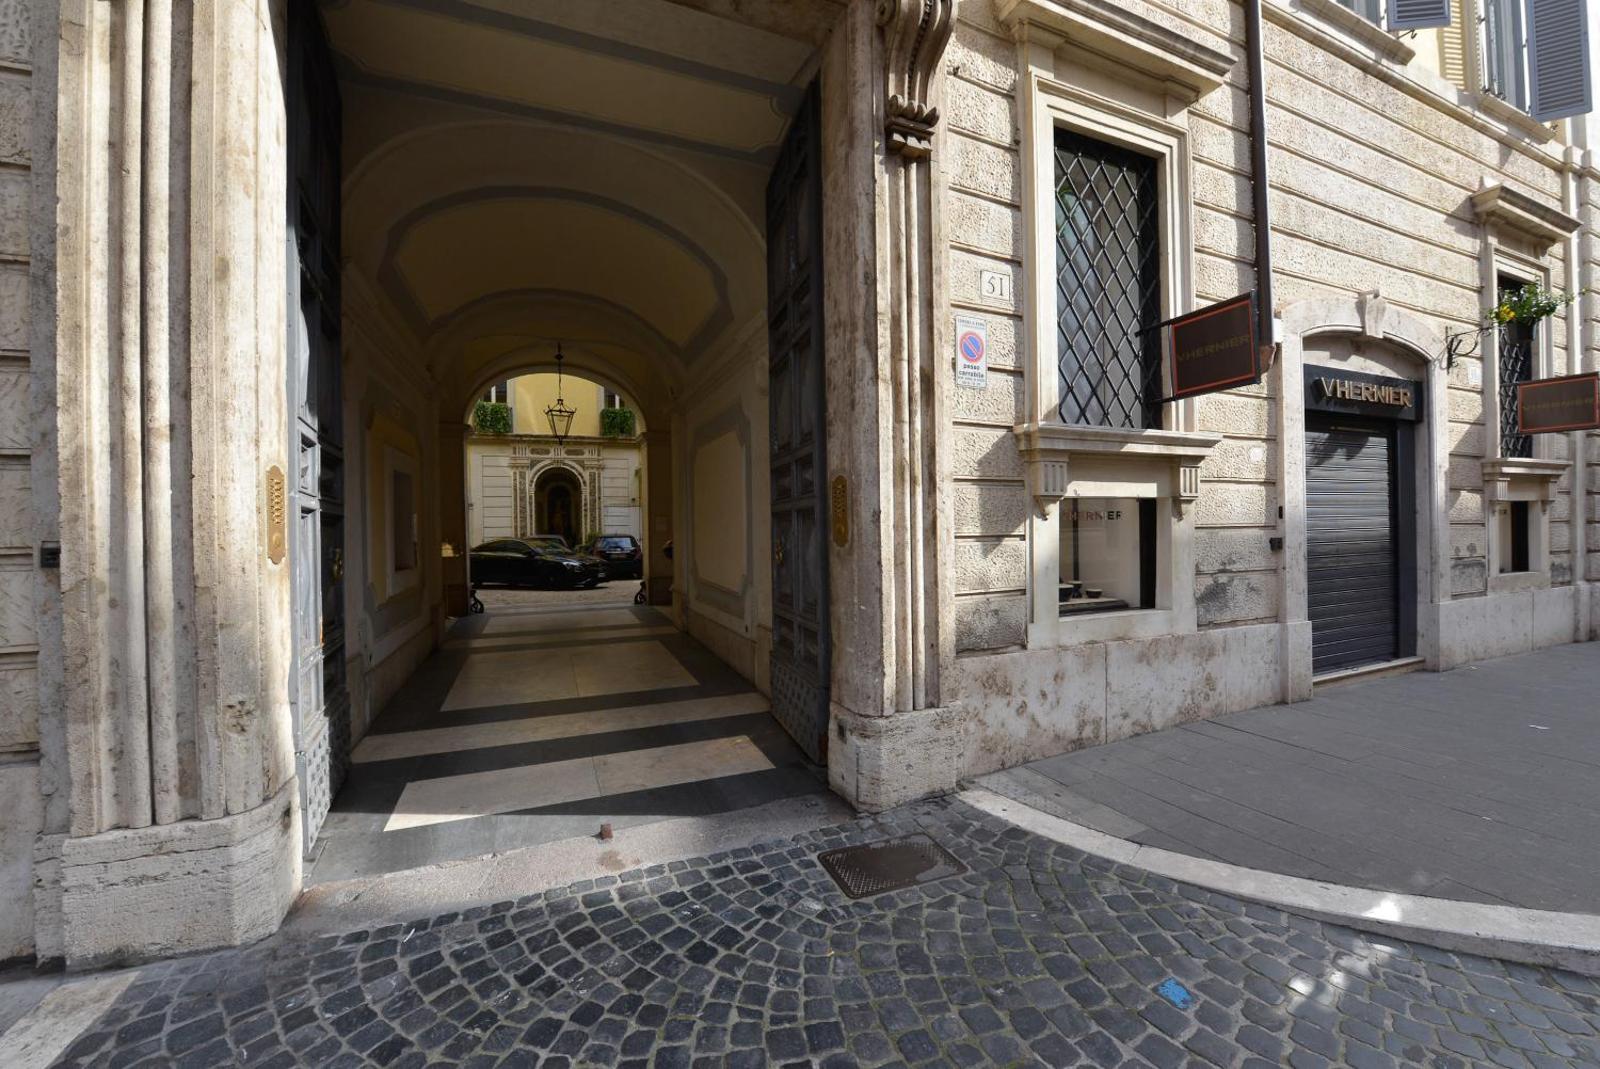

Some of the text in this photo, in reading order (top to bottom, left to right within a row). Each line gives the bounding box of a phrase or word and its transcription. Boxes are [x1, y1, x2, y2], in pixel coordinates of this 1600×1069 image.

[986, 275, 1004, 296] 51
[1320, 376, 1412, 408] VHERNIER
[1063, 510, 1122, 521] HRNIER
